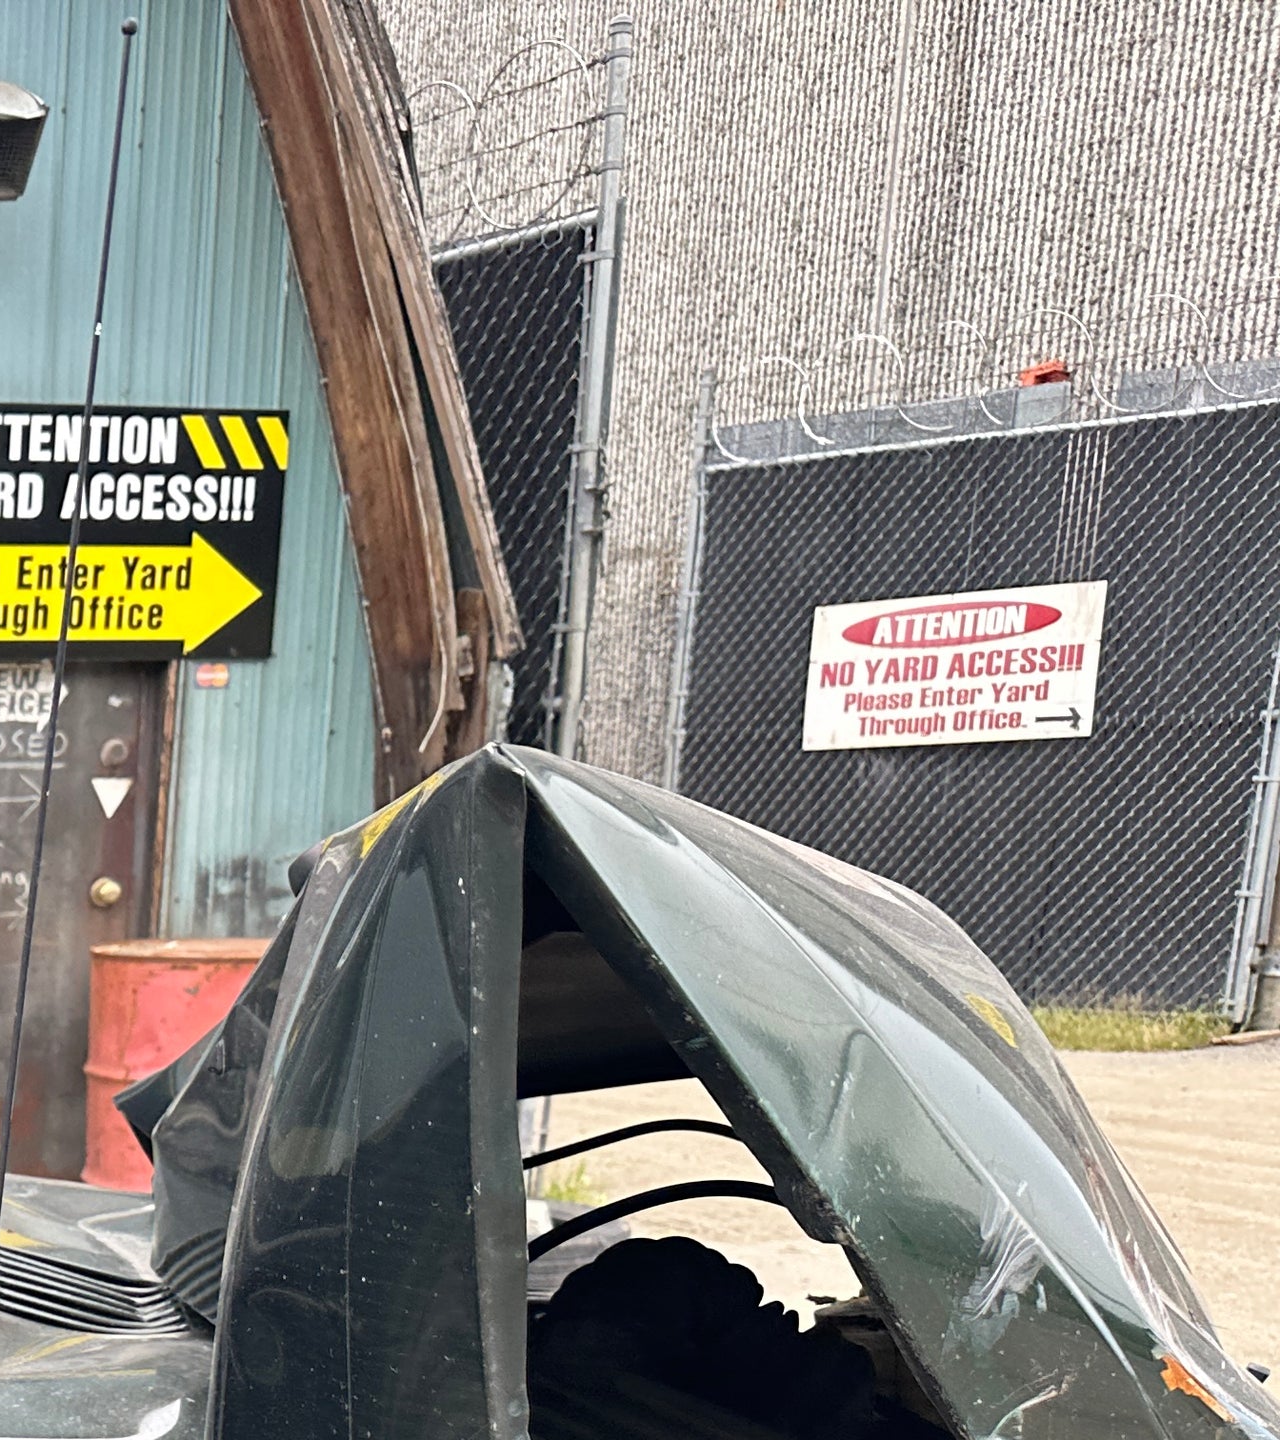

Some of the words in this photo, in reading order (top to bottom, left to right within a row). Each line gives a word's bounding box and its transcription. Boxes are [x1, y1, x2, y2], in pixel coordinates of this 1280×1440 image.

[60, 473, 256, 522] ACCESS!!!
[17, 557, 105, 590] Enter
[124, 556, 193, 591] Yard
[68, 595, 164, 631] Office
[872, 604, 1028, 645] ATTENTION
[820, 662, 855, 688] NO
[865, 655, 939, 685] YARD
[946, 643, 1085, 679] ACCESS!!!
[844, 692, 913, 713] Please
[920, 686, 983, 708] Enter
[991, 680, 1050, 703] Yard
[859, 712, 945, 737] Through
